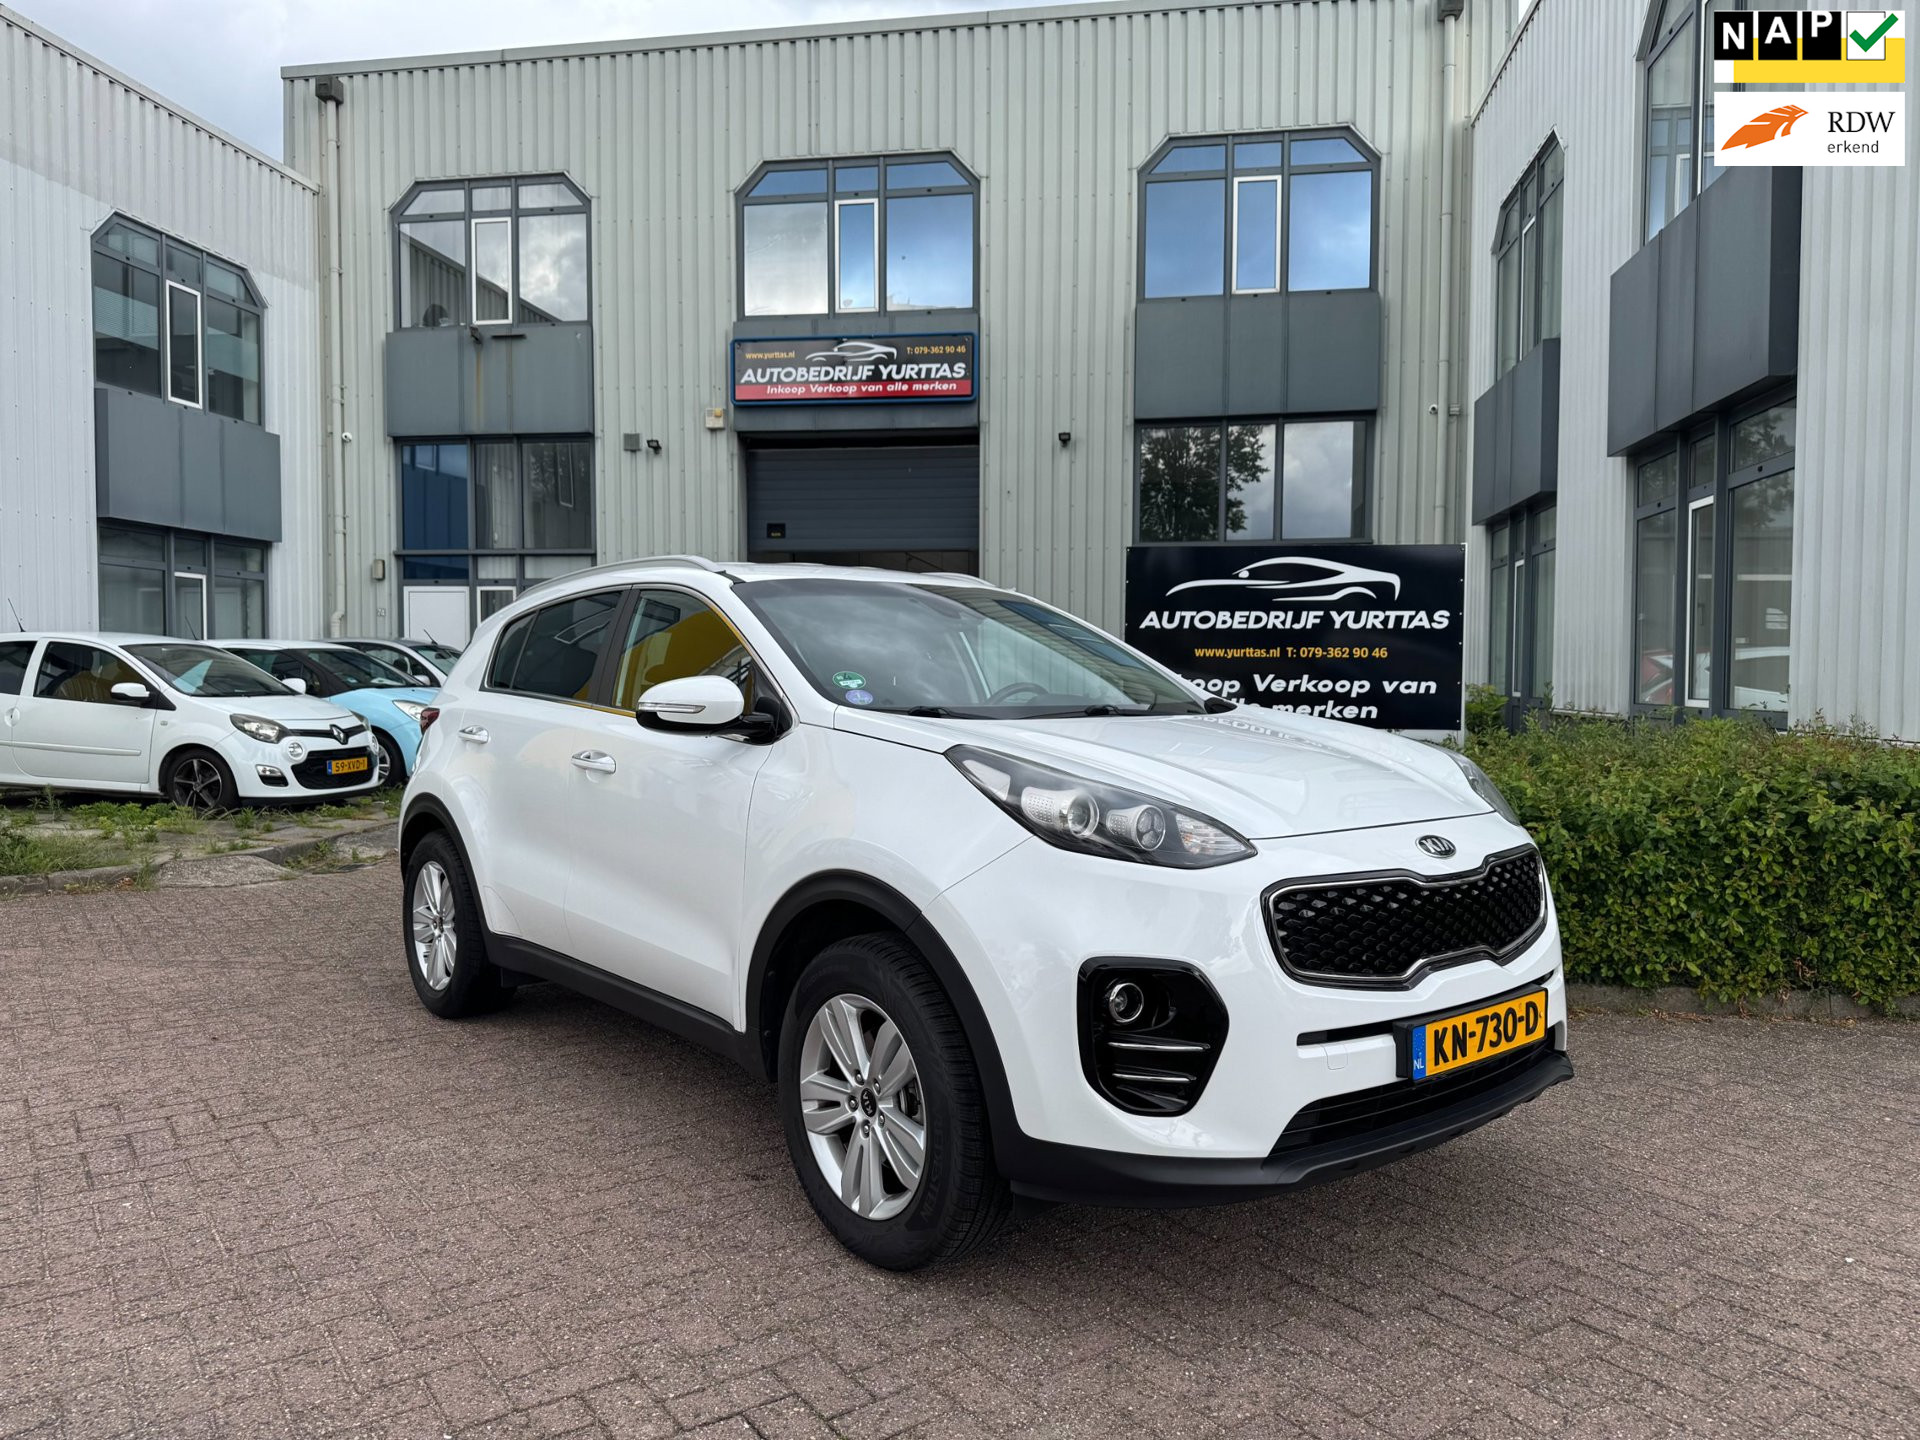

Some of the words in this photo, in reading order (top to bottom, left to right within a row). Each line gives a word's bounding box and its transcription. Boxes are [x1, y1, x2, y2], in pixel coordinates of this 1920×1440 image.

[745, 350, 796, 360] www.yurttas.nl
[914, 345, 944, 355] 079-362
[945, 345, 955, 354] 90
[955, 344, 967, 353] 46
[740, 365, 874, 384] AUTOBEDRIJF
[878, 362, 967, 380] YURTTAS
[766, 385, 806, 396] Inkoop
[810, 383, 857, 396] Verkoop
[861, 384, 883, 392] van
[886, 382, 909, 392] alle
[912, 381, 957, 391] merken
[1139, 610, 1325, 630] AUTOBEDRIJF
[1329, 609, 1450, 630] YURTTAS
[1194, 646, 1280, 660] www.yurttas.nl
[1286, 647, 1297, 658] T:
[1299, 646, 1350, 659] 079-362
[1352, 647, 1369, 659] 90
[1371, 647, 1388, 659] 46
[1253, 674, 1370, 699] Verkoop
[1382, 679, 1437, 695] van
[335, 759, 365, 772] 59-XVD-1
[1433, 1000, 1539, 1067] KN-730-D
[1413, 1058, 1425, 1070] NL
